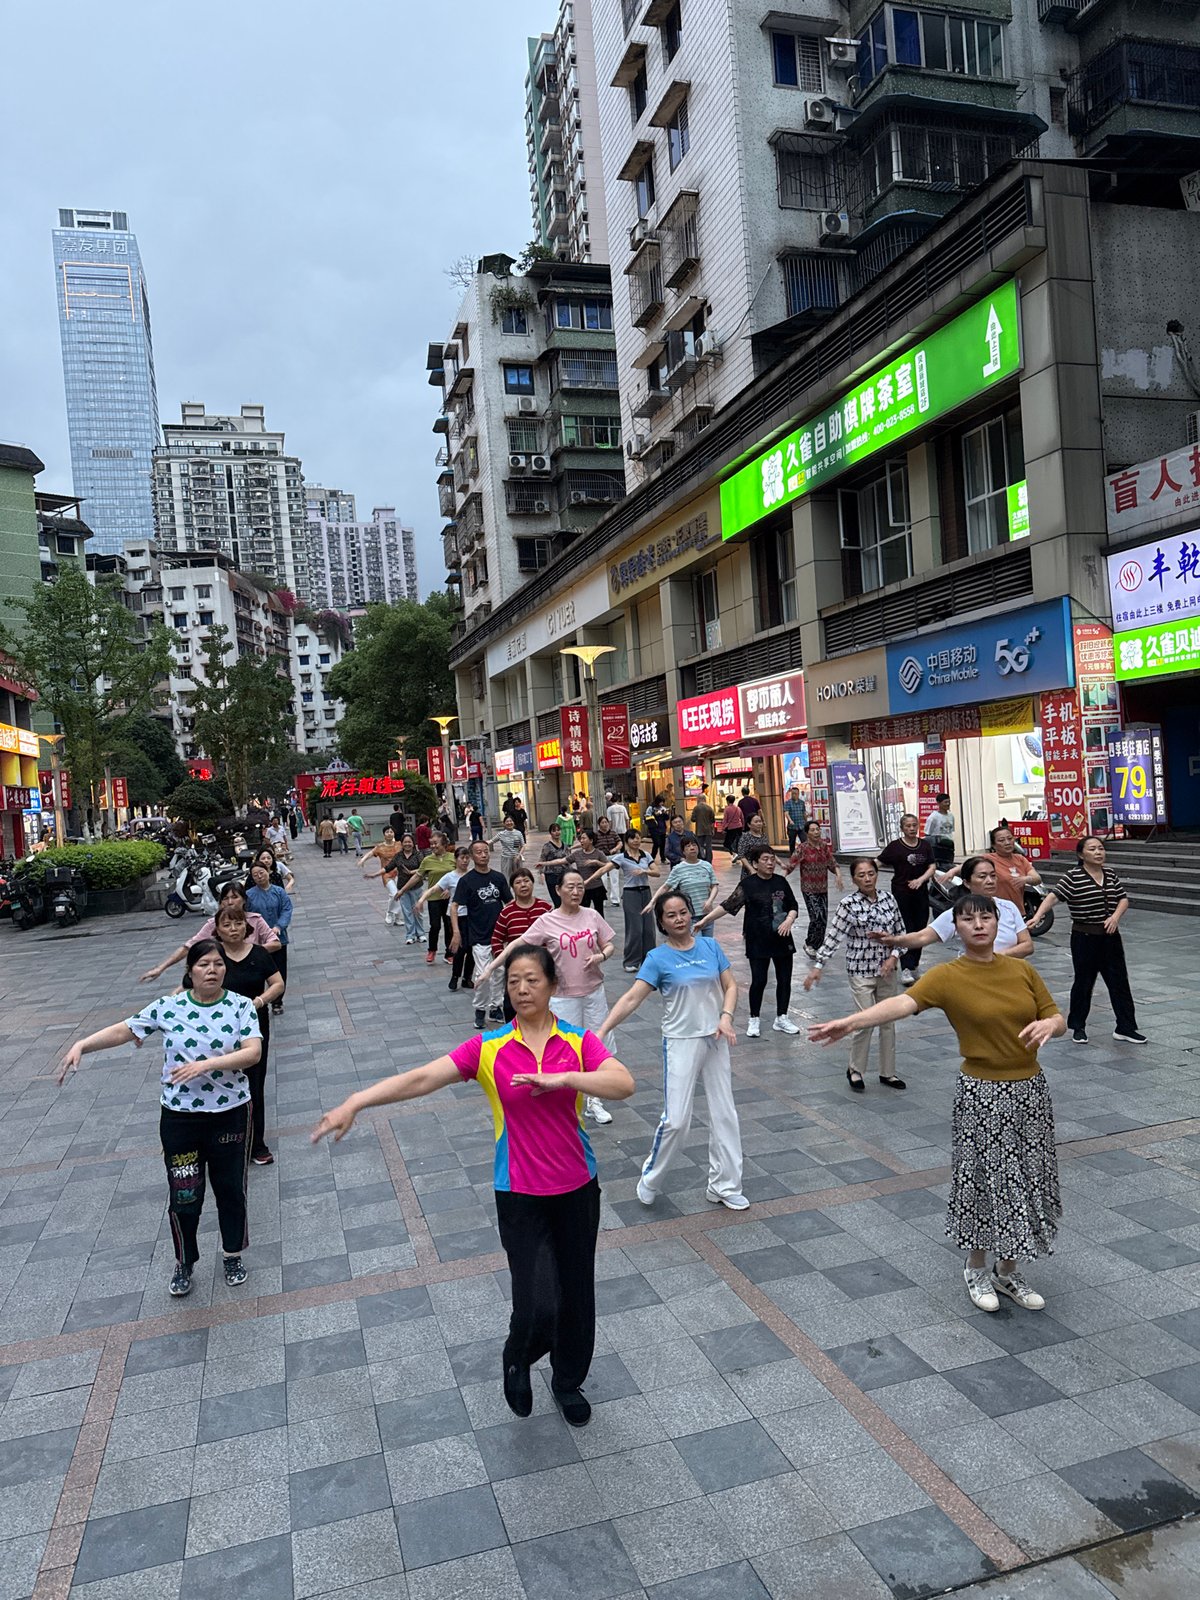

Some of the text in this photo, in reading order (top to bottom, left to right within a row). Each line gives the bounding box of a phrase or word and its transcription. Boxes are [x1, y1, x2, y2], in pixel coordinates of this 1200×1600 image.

[62, 237, 128, 255] 嘉发集团
[786, 362, 914, 474] 久雀自助棋牌茶室
[1116, 603, 1164, 623] 住宿由此上三楼
[927, 643, 976, 671] 中国移动
[928, 667, 979, 686] China Mobile
[746, 681, 795, 713] 都市丽人
[816, 675, 876, 702] HONOR 荣耀
[1043, 702, 1076, 723] 手机
[568, 710, 584, 768] 诗情装饰
[1044, 725, 1077, 748] 平板
[1109, 739, 1150, 757] 四季轻住酒店
[1045, 749, 1079, 762] 智能手表
[920, 767, 943, 781] 打话费
[1115, 765, 1147, 798] 79
[1152, 736, 1165, 815] 四季轻住酒店
[1053, 787, 1083, 807] 500
[560, 928, 593, 959] Juicy
